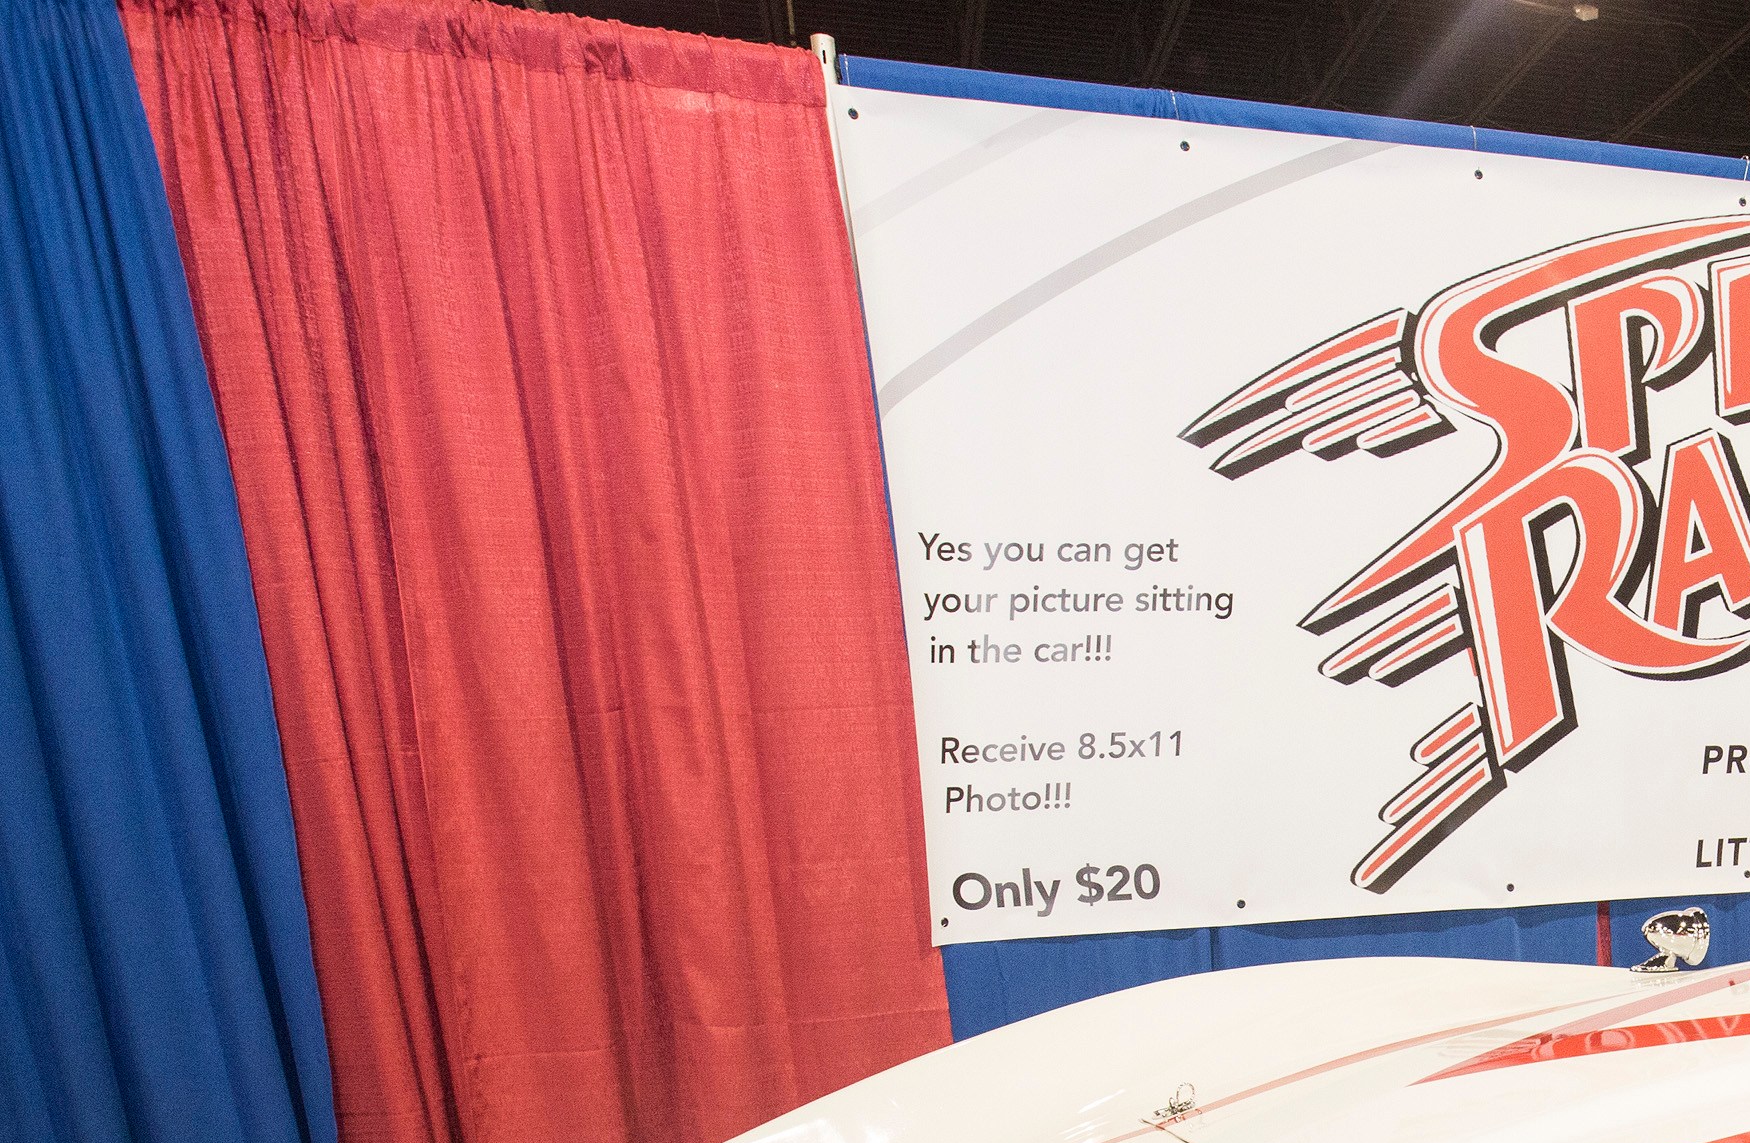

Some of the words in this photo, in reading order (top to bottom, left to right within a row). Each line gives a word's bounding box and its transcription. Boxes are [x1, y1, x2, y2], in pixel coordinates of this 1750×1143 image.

[917, 532, 973, 562] Yes
[982, 541, 1046, 571] you
[1056, 540, 1112, 563] can
[1123, 538, 1179, 571] get
[923, 591, 998, 621] your
[1008, 585, 1124, 621] picture
[1134, 584, 1235, 620] sitting
[929, 636, 956, 664] in
[967, 634, 1022, 664] the
[1033, 634, 1113, 662] car!!!
[939, 734, 1066, 765] Receive
[1077, 730, 1183, 760] 8.5x11
[944, 782, 1072, 814] Photo!!!
[952, 868, 1061, 918] Only
[1075, 862, 1161, 907] $20
